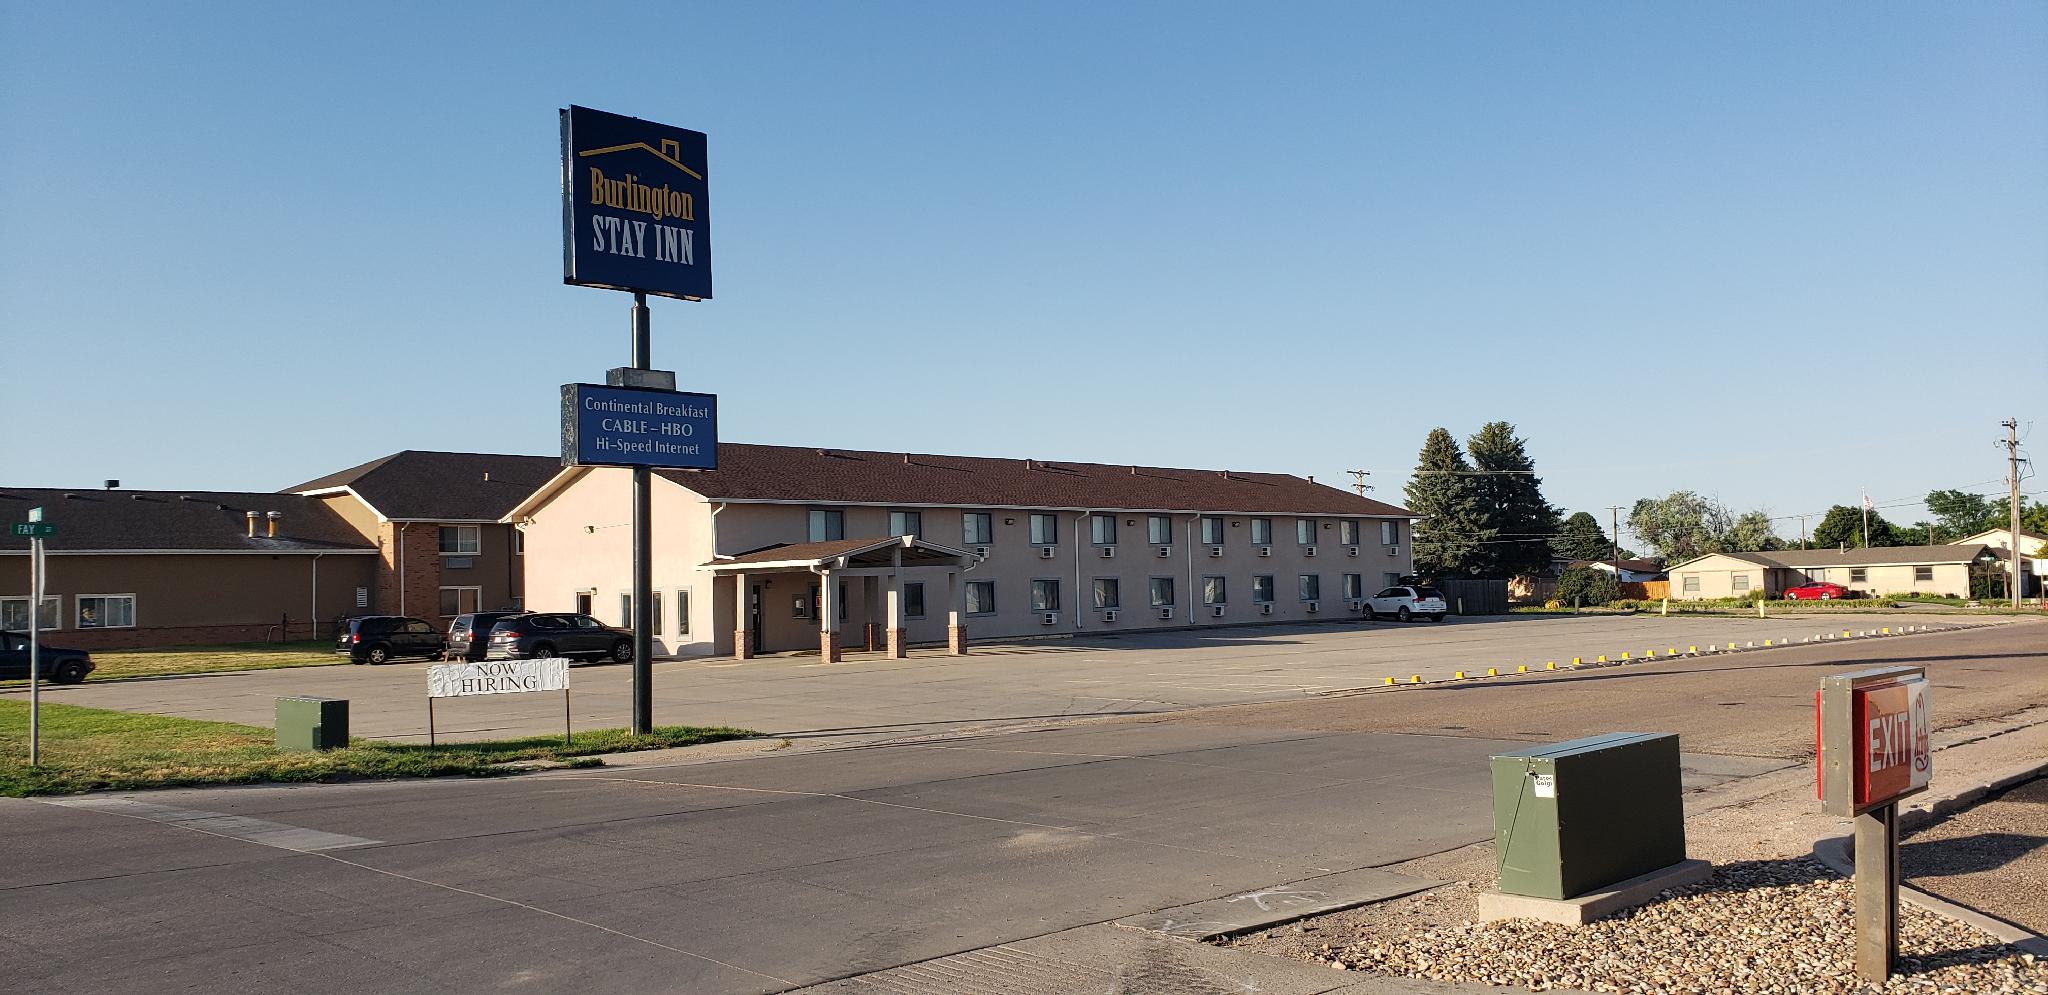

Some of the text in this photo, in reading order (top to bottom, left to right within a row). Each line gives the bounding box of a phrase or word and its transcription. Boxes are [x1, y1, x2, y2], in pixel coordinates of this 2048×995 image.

[590, 167, 694, 220] Burlington
[592, 214, 694, 265] STAY INN
[585, 396, 709, 419] Continental Breakfast
[602, 418, 648, 434] CABLE
[661, 422, 693, 437] HBO
[655, 440, 700, 455] Internet
[17, 524, 35, 535] FAY
[477, 662, 519, 677] NOW
[461, 675, 537, 692] HIRING
[1869, 711, 1909, 772] EXIT
